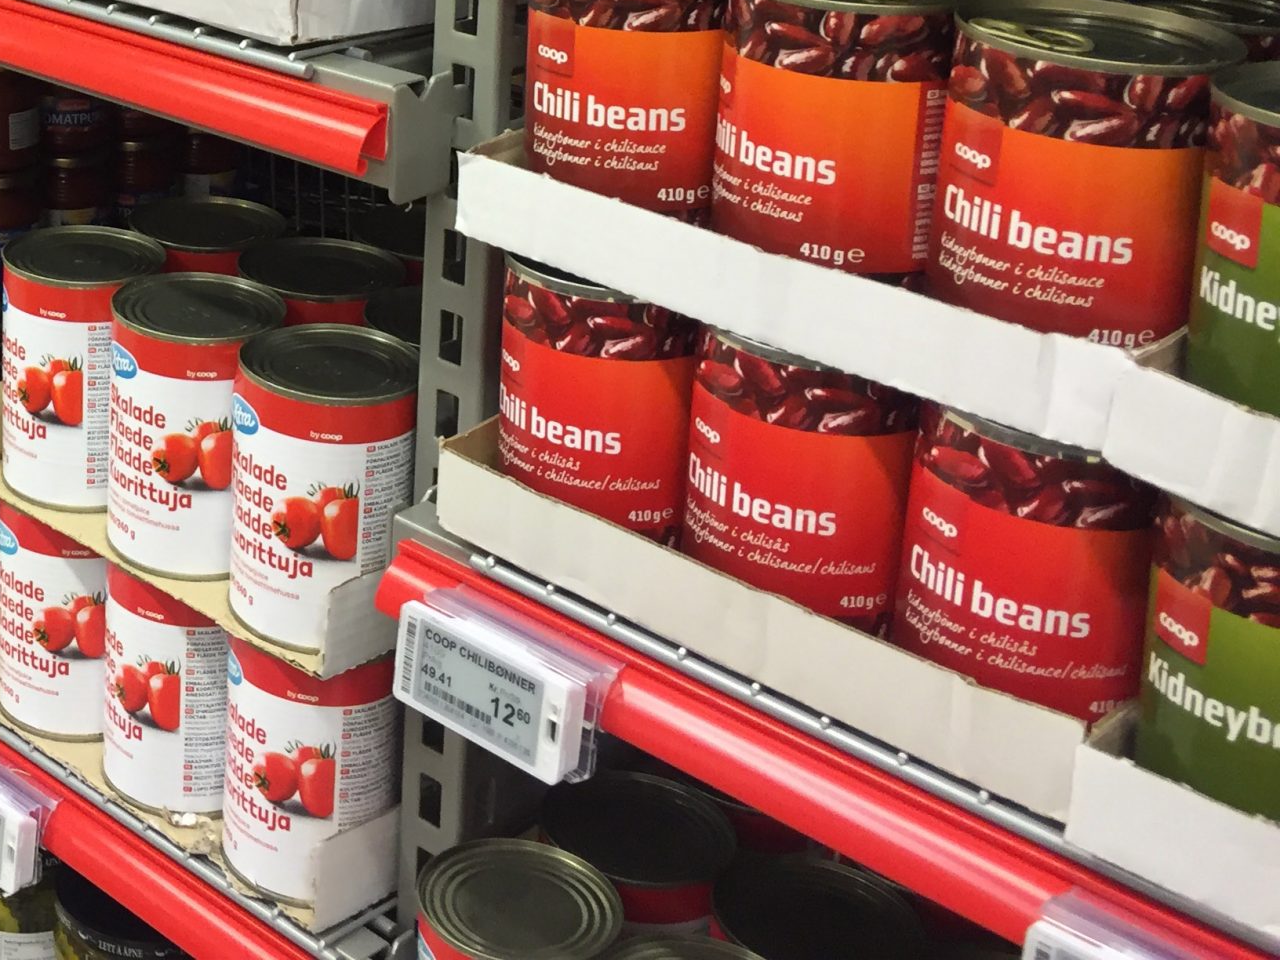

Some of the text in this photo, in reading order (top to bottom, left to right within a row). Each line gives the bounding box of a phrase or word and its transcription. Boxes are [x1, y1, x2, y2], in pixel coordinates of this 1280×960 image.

[537, 43, 568, 65] coop
[533, 80, 686, 133] Chili beans
[604, 139, 667, 155] chilisauce
[954, 141, 992, 170] coop
[604, 154, 660, 173] chilisaus
[740, 138, 837, 186] beans
[751, 179, 813, 206] chilisauce
[750, 200, 804, 223] chilisaus
[943, 183, 1134, 266] Chili beans
[1210, 219, 1251, 252] coop
[1025, 263, 1106, 290] chilisauce
[1023, 283, 1094, 309] chilisaus
[48, 311, 67, 319] coop
[110, 383, 166, 429] Skalade
[321, 433, 343, 441] coop
[531, 406, 622, 457] beans
[695, 417, 721, 444] coop
[109, 460, 192, 512] Kuorittuja
[689, 451, 837, 537] Chili beans
[922, 505, 959, 540] coop
[740, 528, 791, 553] chilisås
[909, 542, 1092, 639] Chili beans
[980, 629, 1039, 658] chilisås
[1158, 611, 1200, 648] coop
[421, 662, 452, 688] 49.41
[425, 627, 536, 695] COOP CHILIBØNNER
[297, 693, 319, 702] coop
